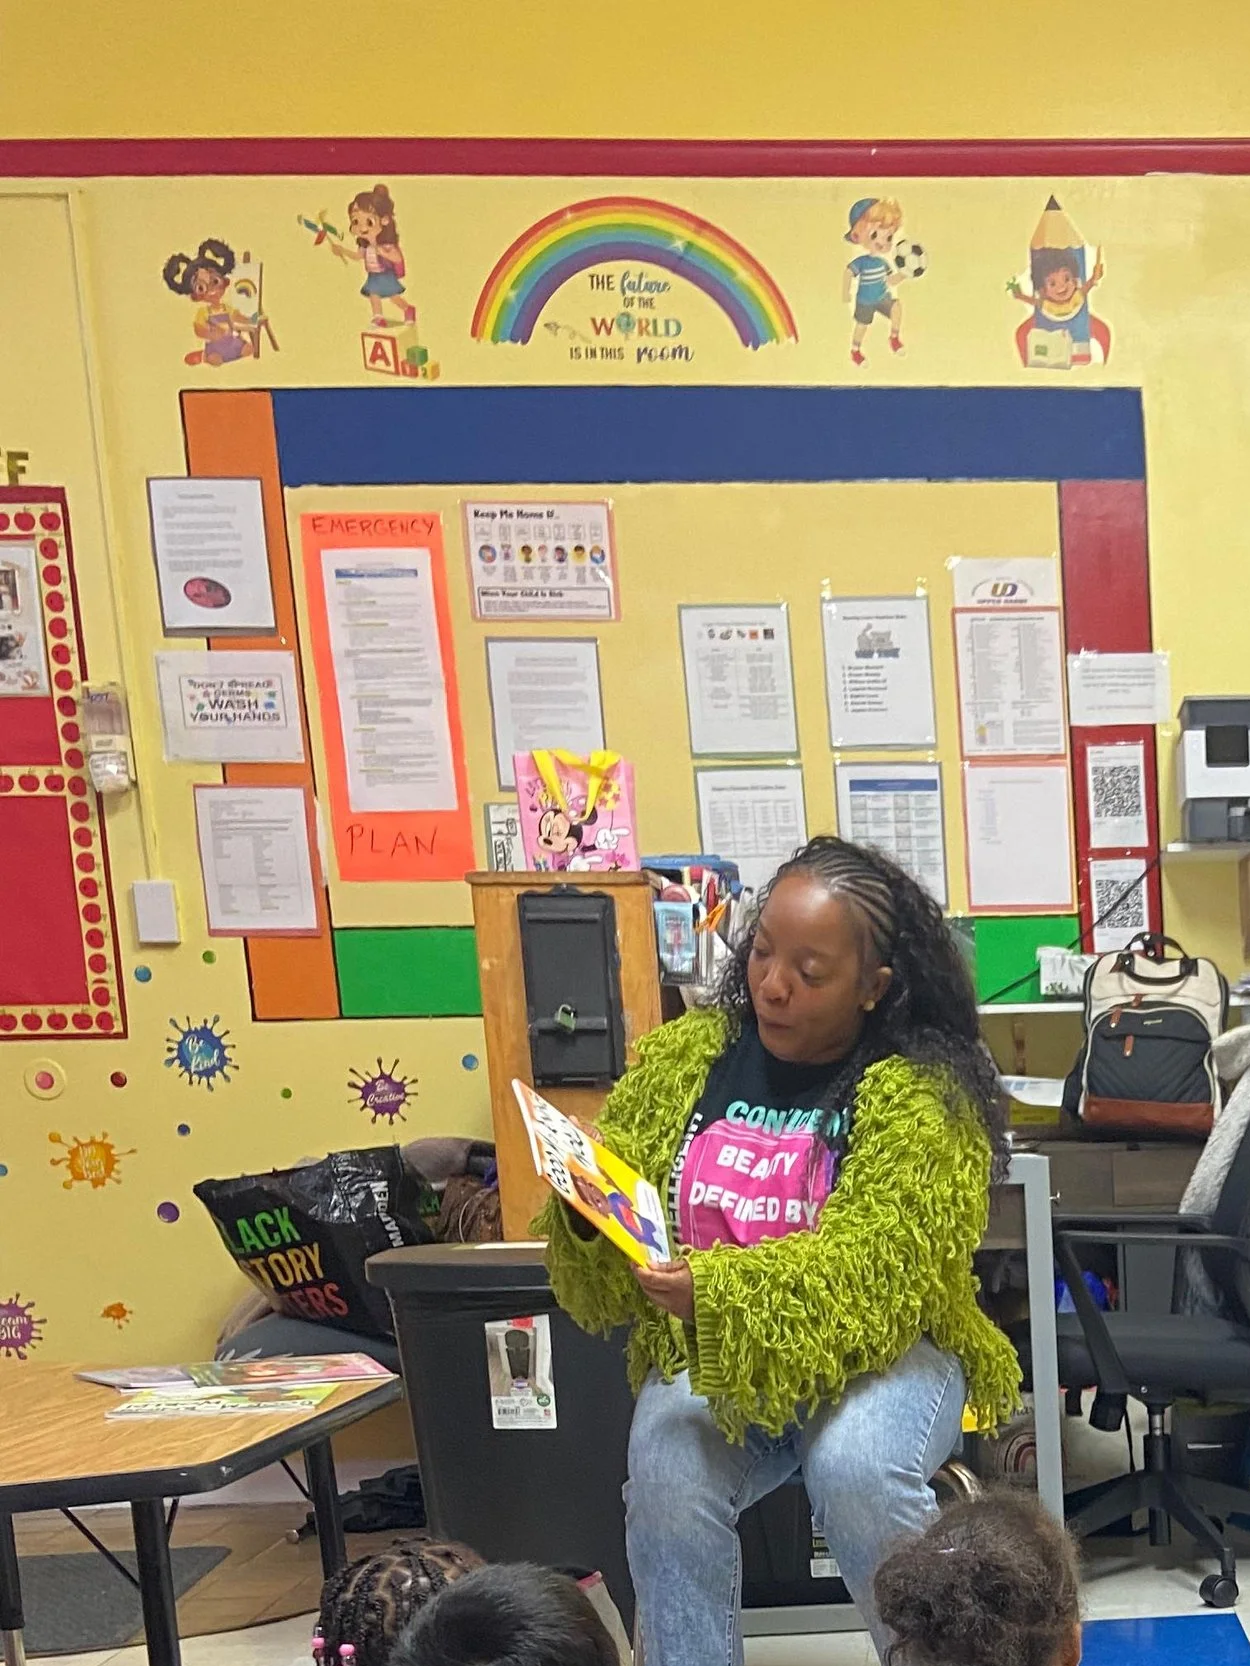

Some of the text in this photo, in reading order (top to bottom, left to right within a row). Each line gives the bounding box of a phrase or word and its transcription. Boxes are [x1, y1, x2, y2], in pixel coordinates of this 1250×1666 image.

[589, 270, 671, 296] THE future
[623, 297, 656, 309] OF THE
[590, 312, 682, 338] WORLD
[369, 341, 391, 366] A
[570, 344, 695, 364] IS IN THIS room
[0, 452, 28, 487] F
[312, 516, 434, 536] EMERGENCY
[473, 509, 497, 521] Keep
[500, 510, 514, 519] Me
[516, 510, 543, 519] Home
[190, 711, 280, 722] YOUR HANDS
[208, 699, 259, 710] WASH
[346, 824, 438, 858] PLAN
[716, 1144, 799, 1181] BEATY
[688, 1181, 819, 1226] DEFINED BY
[232, 1206, 301, 1254] LACK
[289, 1283, 349, 1319] ERS
